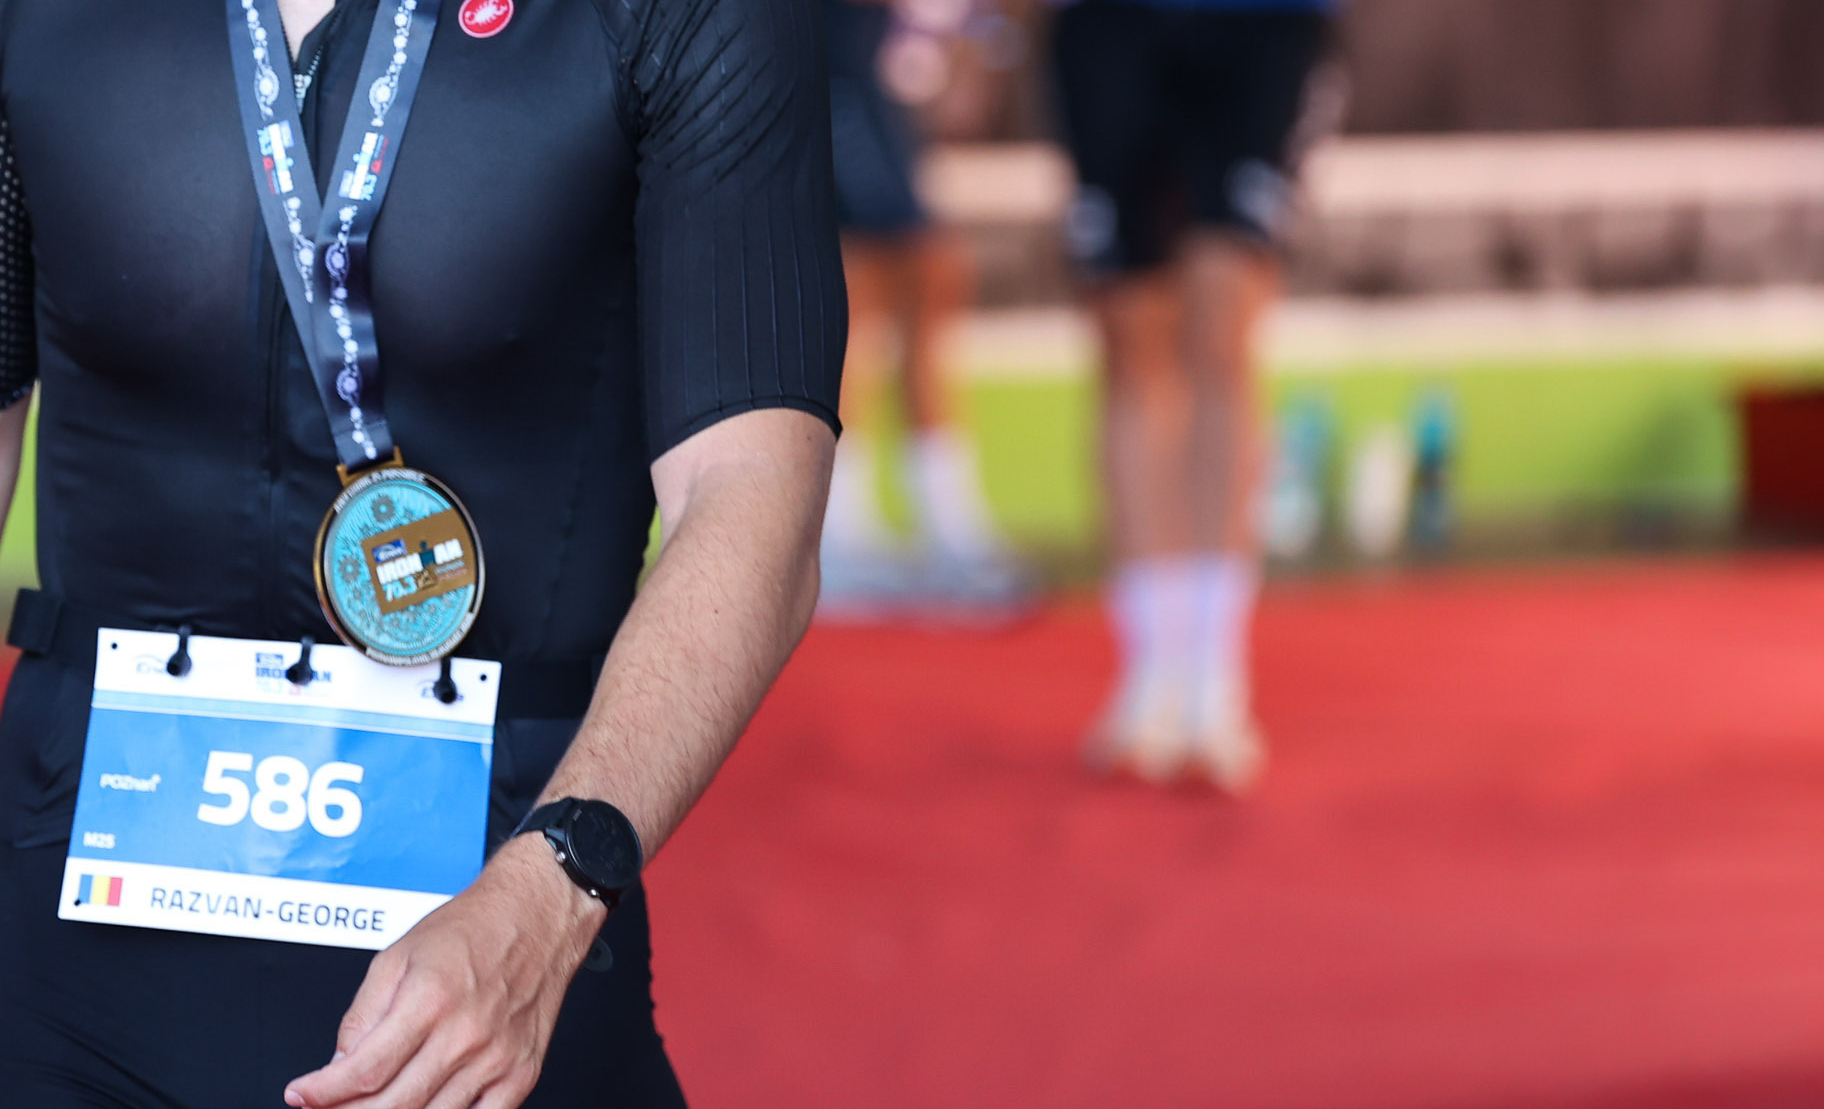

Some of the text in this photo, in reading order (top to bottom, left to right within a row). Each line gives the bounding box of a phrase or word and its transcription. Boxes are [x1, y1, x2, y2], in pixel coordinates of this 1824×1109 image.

[197, 750, 364, 838] 586
[83, 831, 116, 849] M25
[150, 887, 386, 932] RAZVAN-GEORGE
